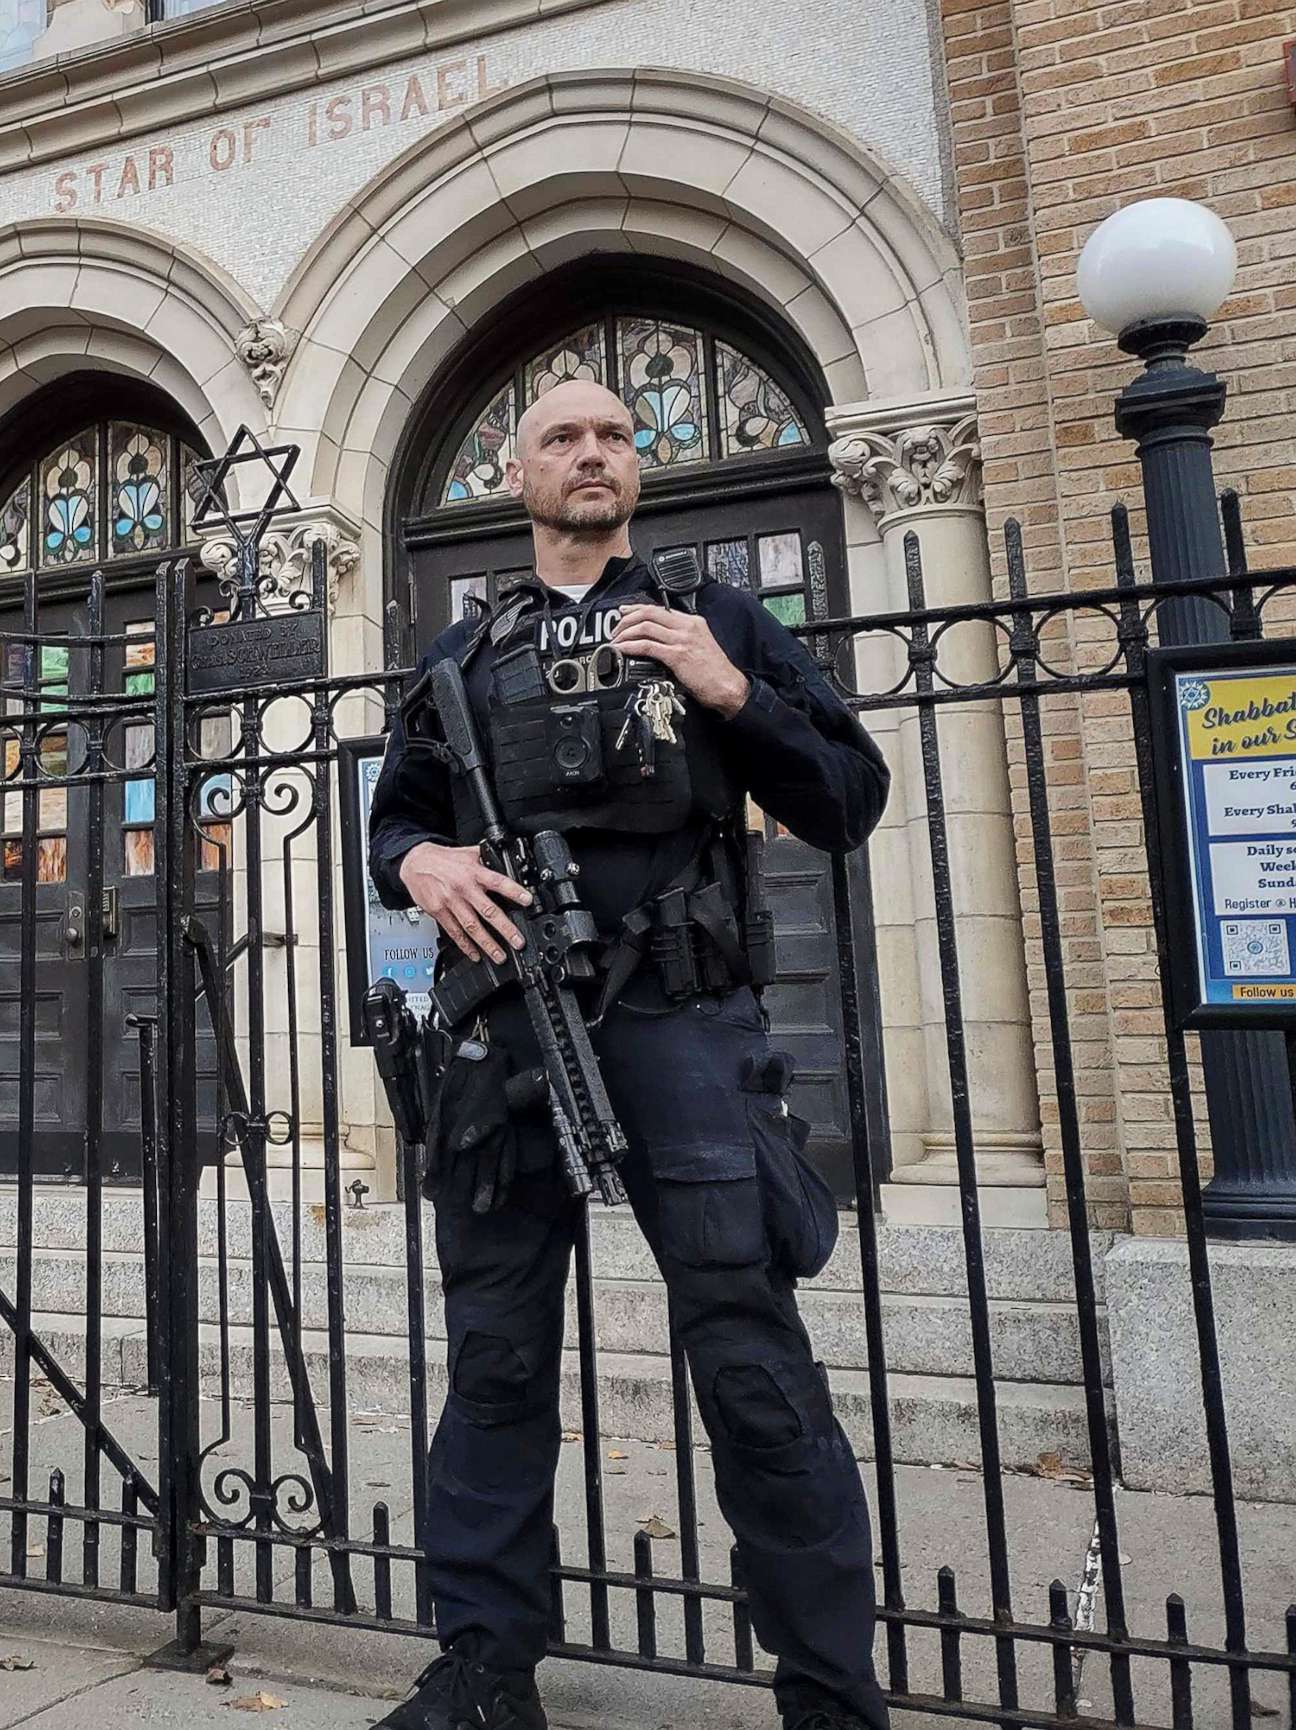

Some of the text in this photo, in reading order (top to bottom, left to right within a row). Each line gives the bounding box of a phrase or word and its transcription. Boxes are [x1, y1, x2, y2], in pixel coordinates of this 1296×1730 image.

[54, 55, 502, 213] STAR OF ISRAEL
[540, 608, 623, 651] POLIC
[1212, 738, 1236, 756] in
[1242, 727, 1281, 749] our
[1229, 766, 1296, 781] Every Fri
[1224, 807, 1265, 818] Every
[1247, 844, 1284, 858] Daily
[1258, 877, 1296, 888] Sund
[1225, 897, 1272, 911] Register
[385, 947, 434, 960] FOLLOW US
[1240, 986, 1294, 997] Follow us
